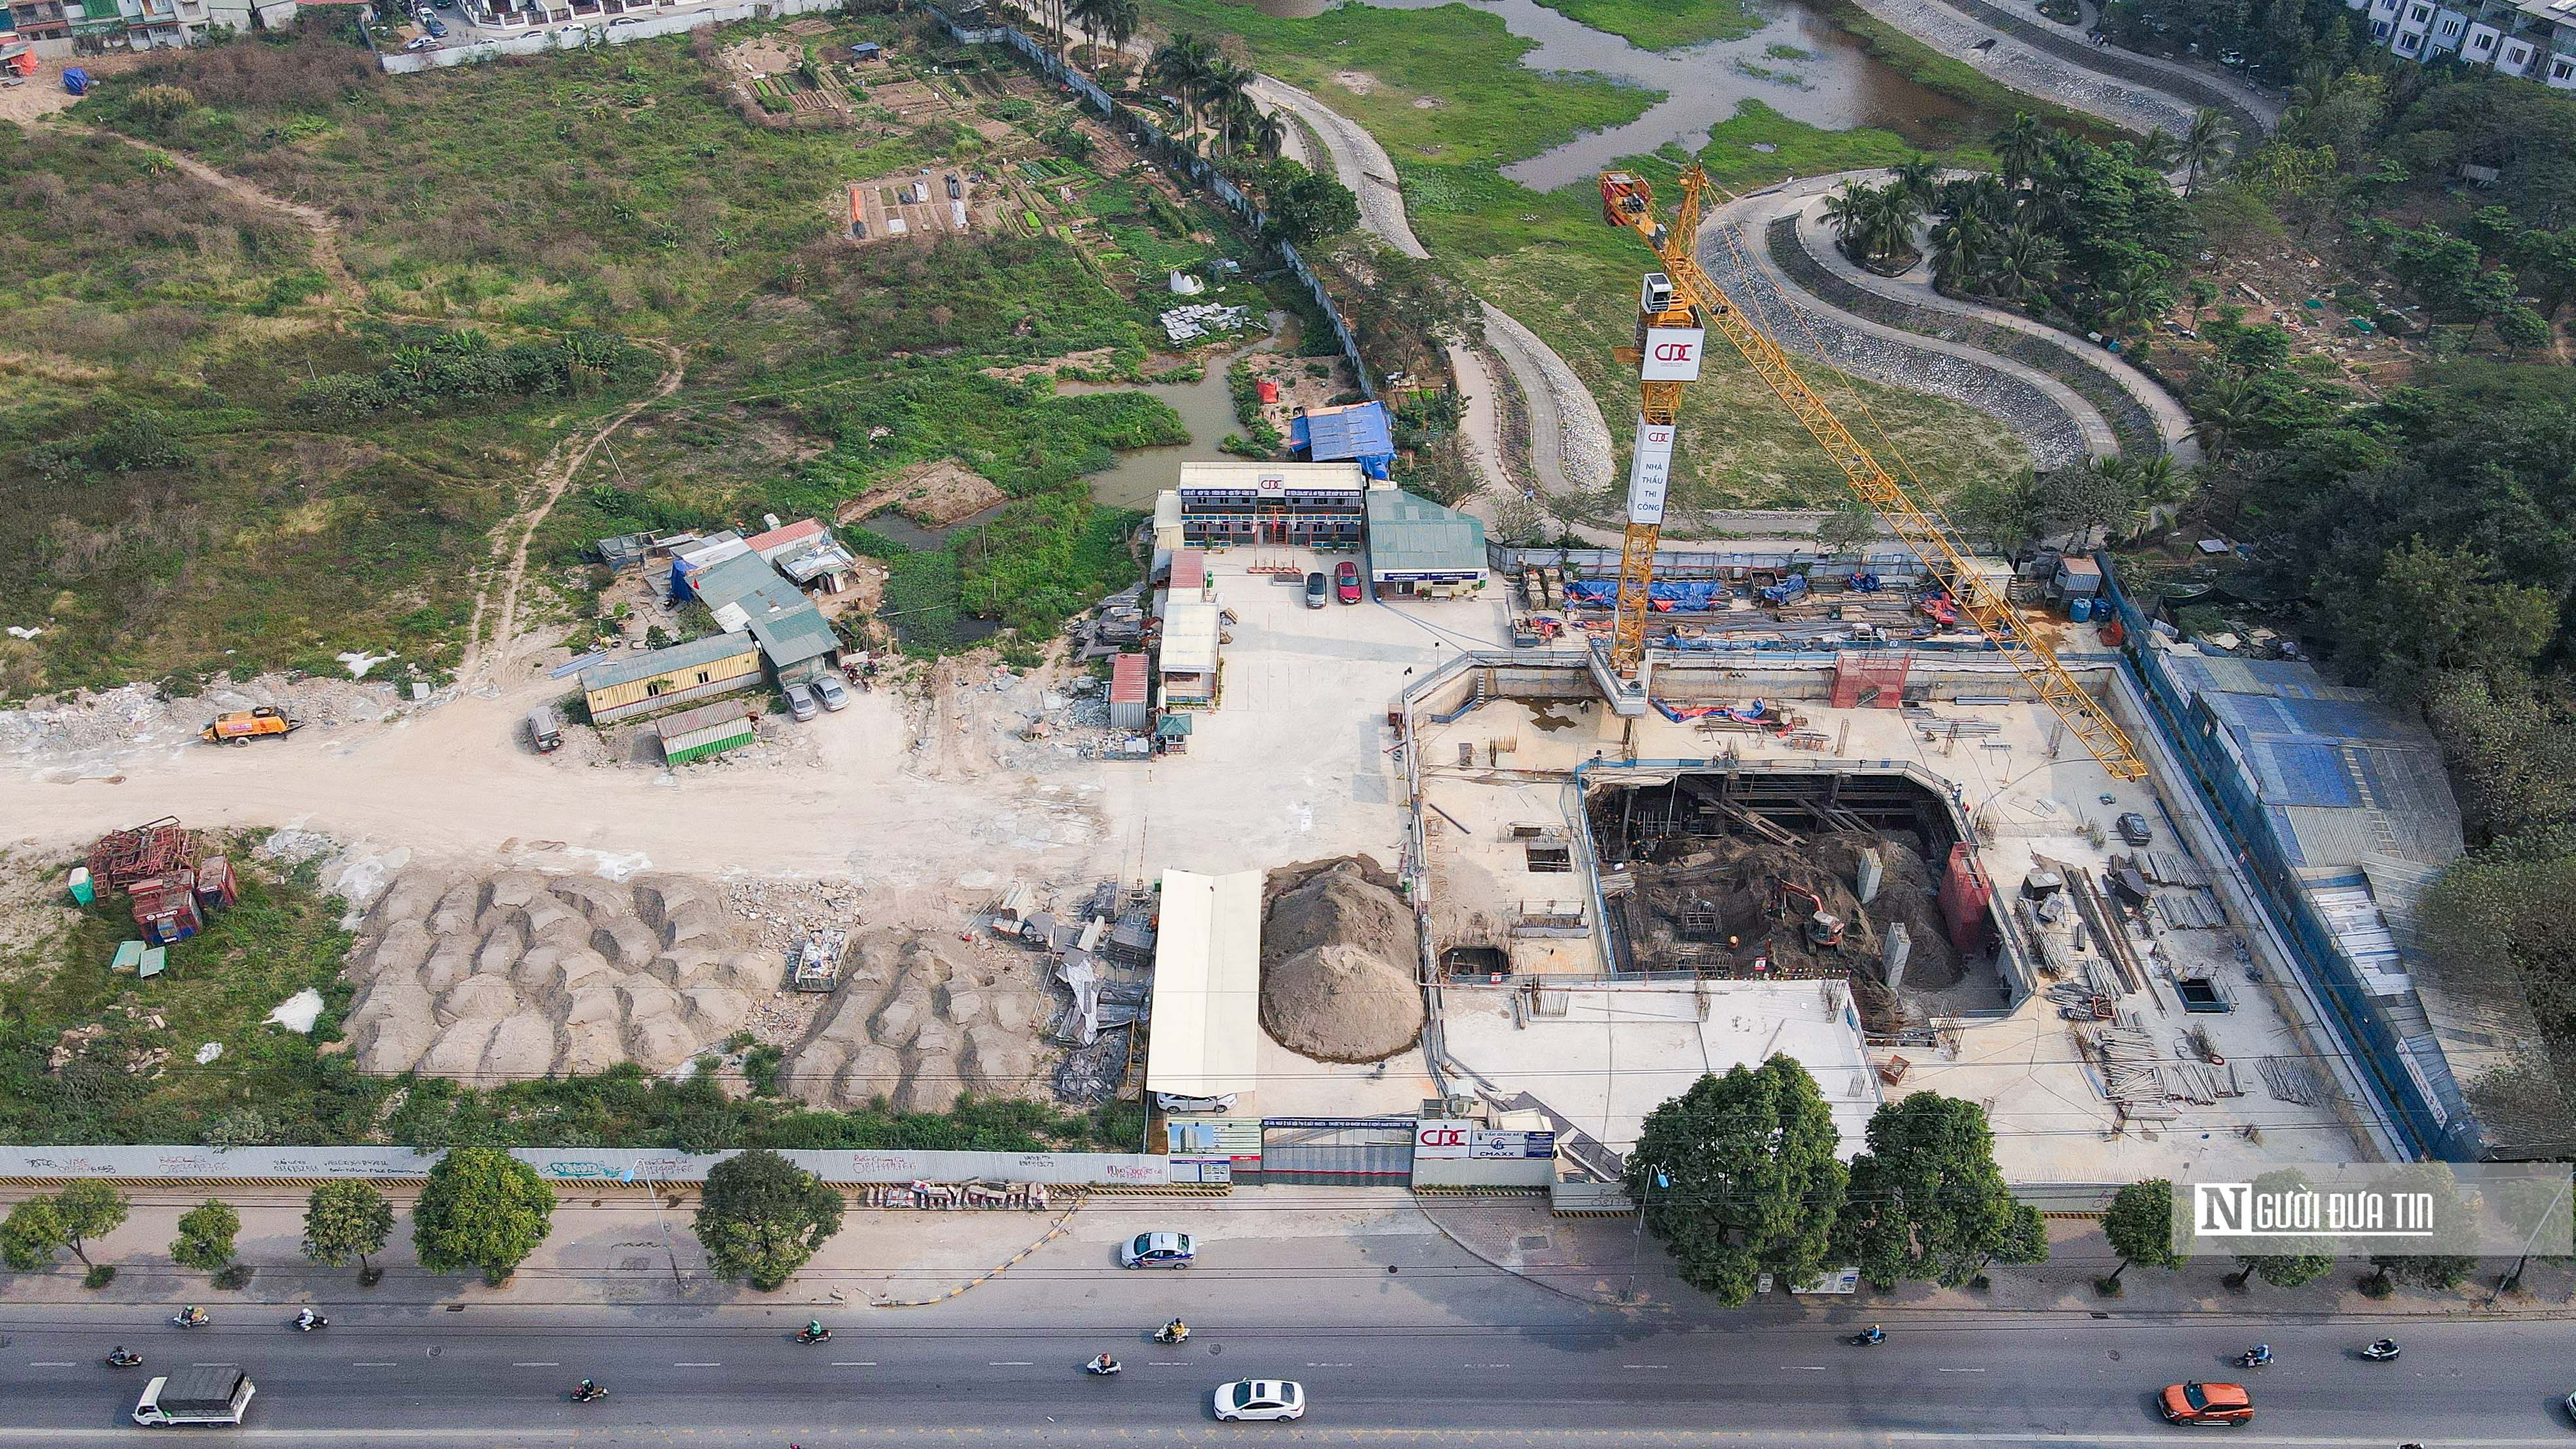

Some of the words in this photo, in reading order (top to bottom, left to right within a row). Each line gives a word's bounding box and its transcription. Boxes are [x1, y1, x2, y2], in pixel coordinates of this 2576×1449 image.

[1655, 344, 1693, 361] CDC
[1645, 461, 1663, 471] NHÀ
[1637, 502, 1660, 511] CÔNG
[1420, 1130, 1467, 1146] CDC
